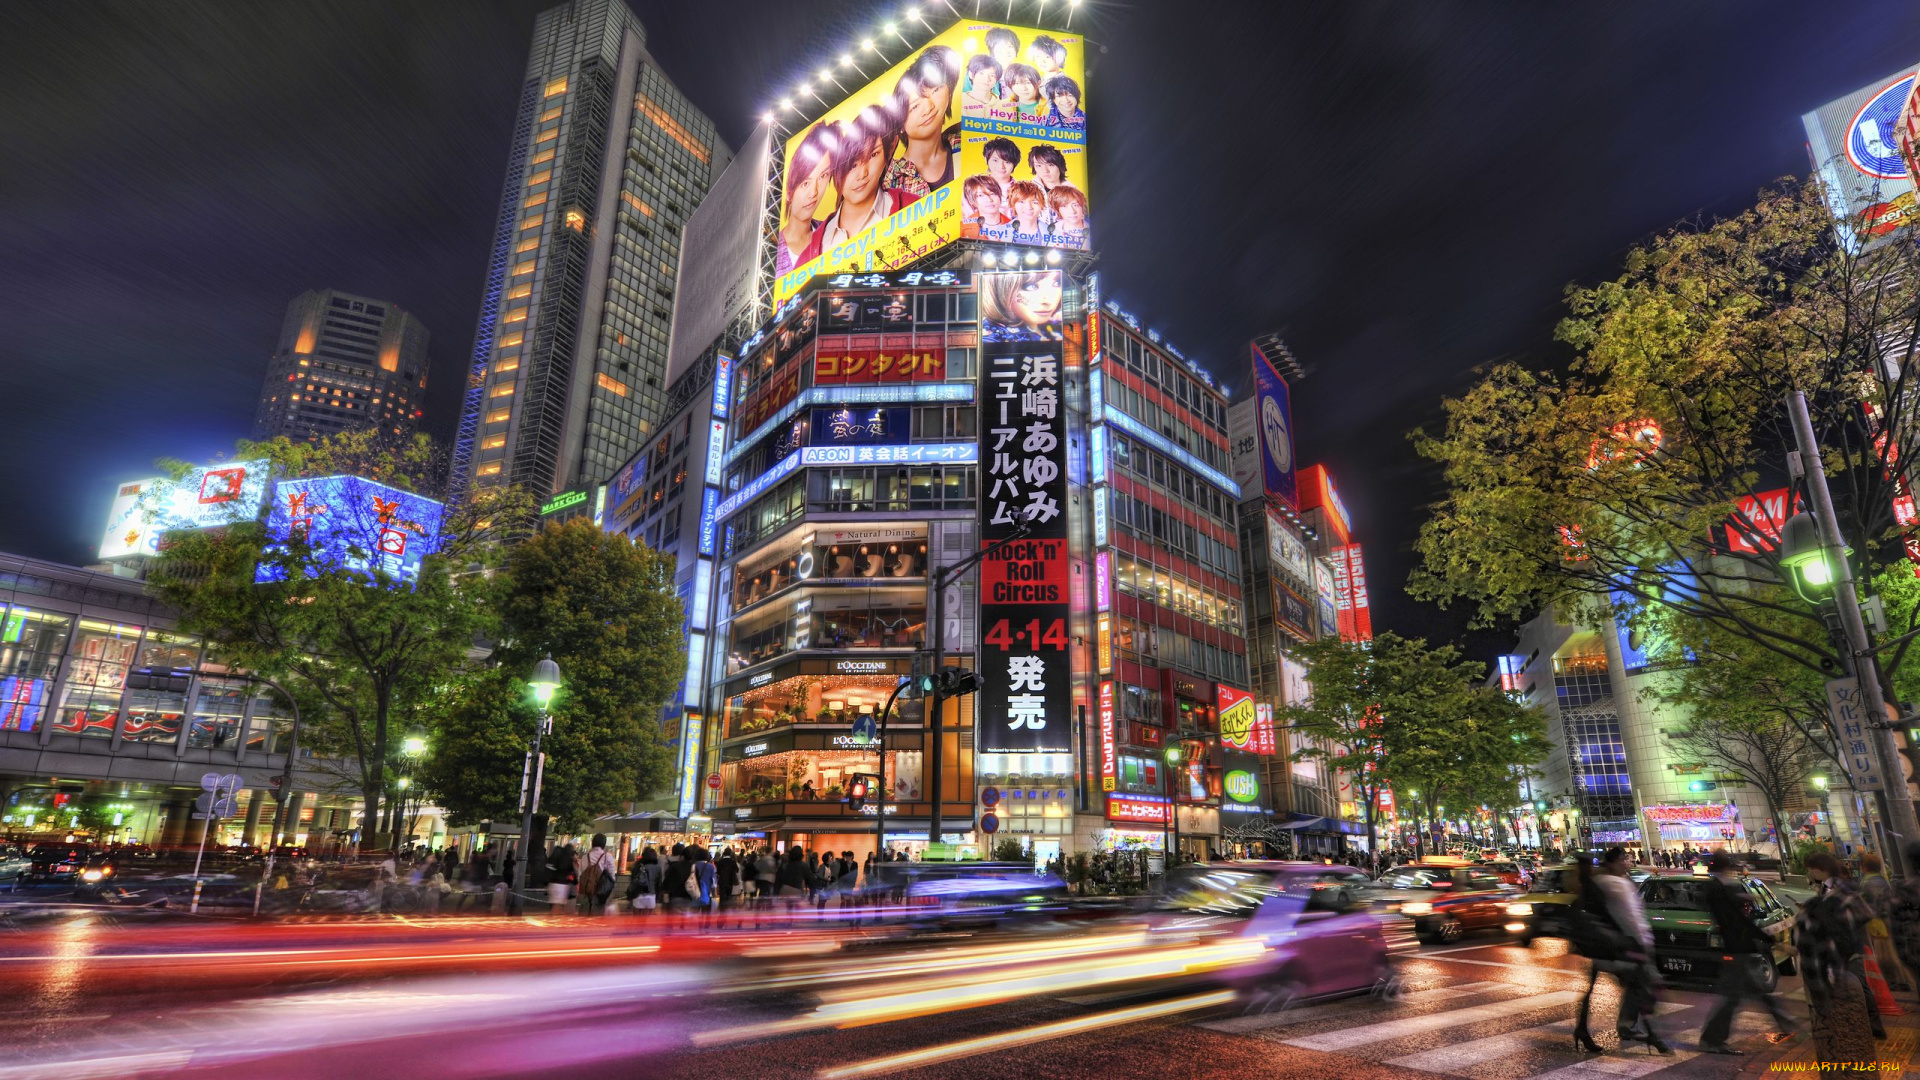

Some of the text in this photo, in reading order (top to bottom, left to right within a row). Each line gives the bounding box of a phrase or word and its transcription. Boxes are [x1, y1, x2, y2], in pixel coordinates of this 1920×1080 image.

[990, 108, 1017, 121] Hey!
[1021, 113, 1046, 123] Say!
[965, 120, 992, 131] Hey!
[996, 123, 1021, 134] Say!
[1048, 130, 1083, 141] JUMP
[782, 186, 951, 293] Hey! Say! JUMP
[980, 228, 1070, 244] Hey! Say! BEST
[817, 353, 942, 376] コンタクト
[989, 358, 1020, 526] ニューアルバム
[1020, 354, 1061, 524] 浜崎あゆみ
[806, 446, 973, 462] AEON 英会話イーオン
[542, 491, 587, 513] MARK CITY
[1743, 496, 1783, 524] H&M
[847, 529, 916, 540] Natural Dining
[988, 541, 1062, 561] Rock'n'
[1007, 561, 1044, 581] Roll
[993, 582, 1058, 602] Circus
[837, 661, 886, 670] L'OCCITANE
[1007, 655, 1046, 731] 発売
[1222, 704, 1253, 733] むじんくん
[833, 736, 882, 745] L'OCANE
[1835, 688, 1871, 773] 文化村通り
[1228, 773, 1255, 795] LUSH
[857, 804, 897, 812] OCCANE
[1690, 826, 1710, 839] 109
[1668, 963, 1692, 972] 84-77
